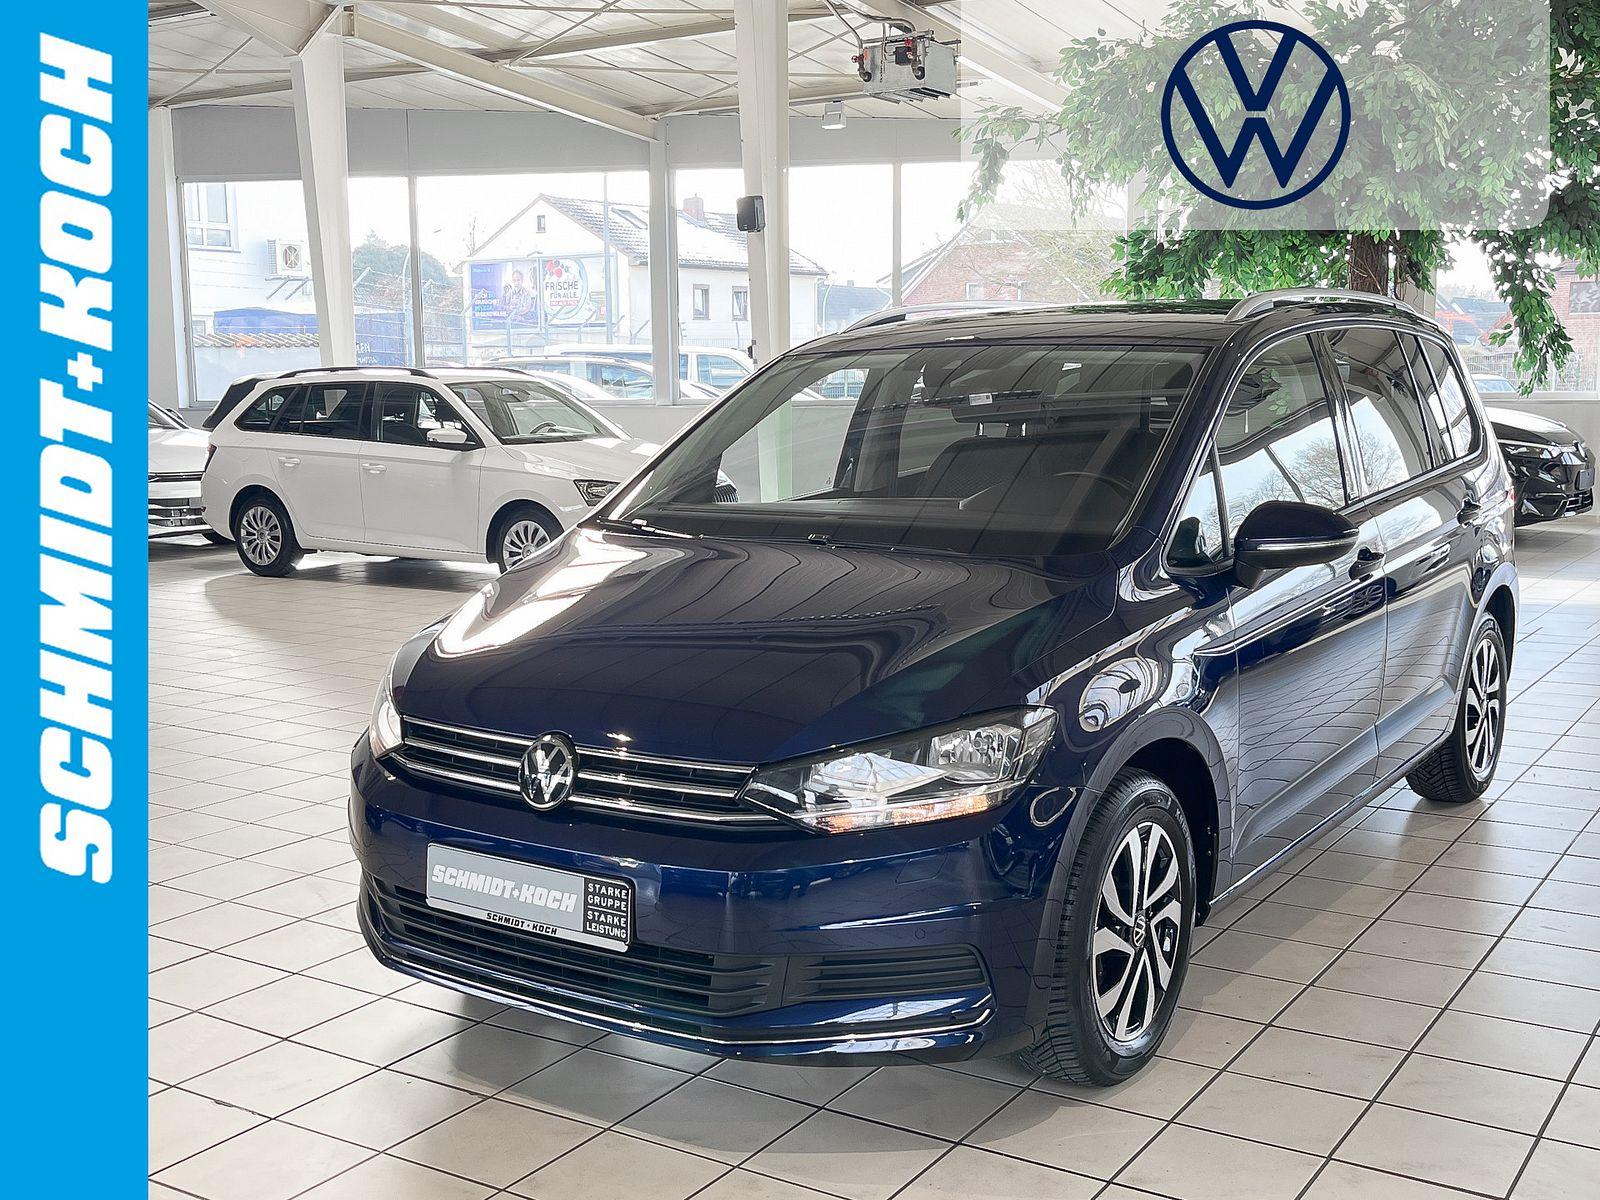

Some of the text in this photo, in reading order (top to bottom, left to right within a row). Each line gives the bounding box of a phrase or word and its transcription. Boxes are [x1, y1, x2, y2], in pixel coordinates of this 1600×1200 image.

[588, 883, 628, 899] STARKE
[587, 894, 627, 911] GRUPPE
[486, 912, 526, 929] SCHMIDT
[532, 922, 558, 936] KOCH
[587, 910, 626, 928] STARKE
[586, 921, 626, 939] LEISTUNG
